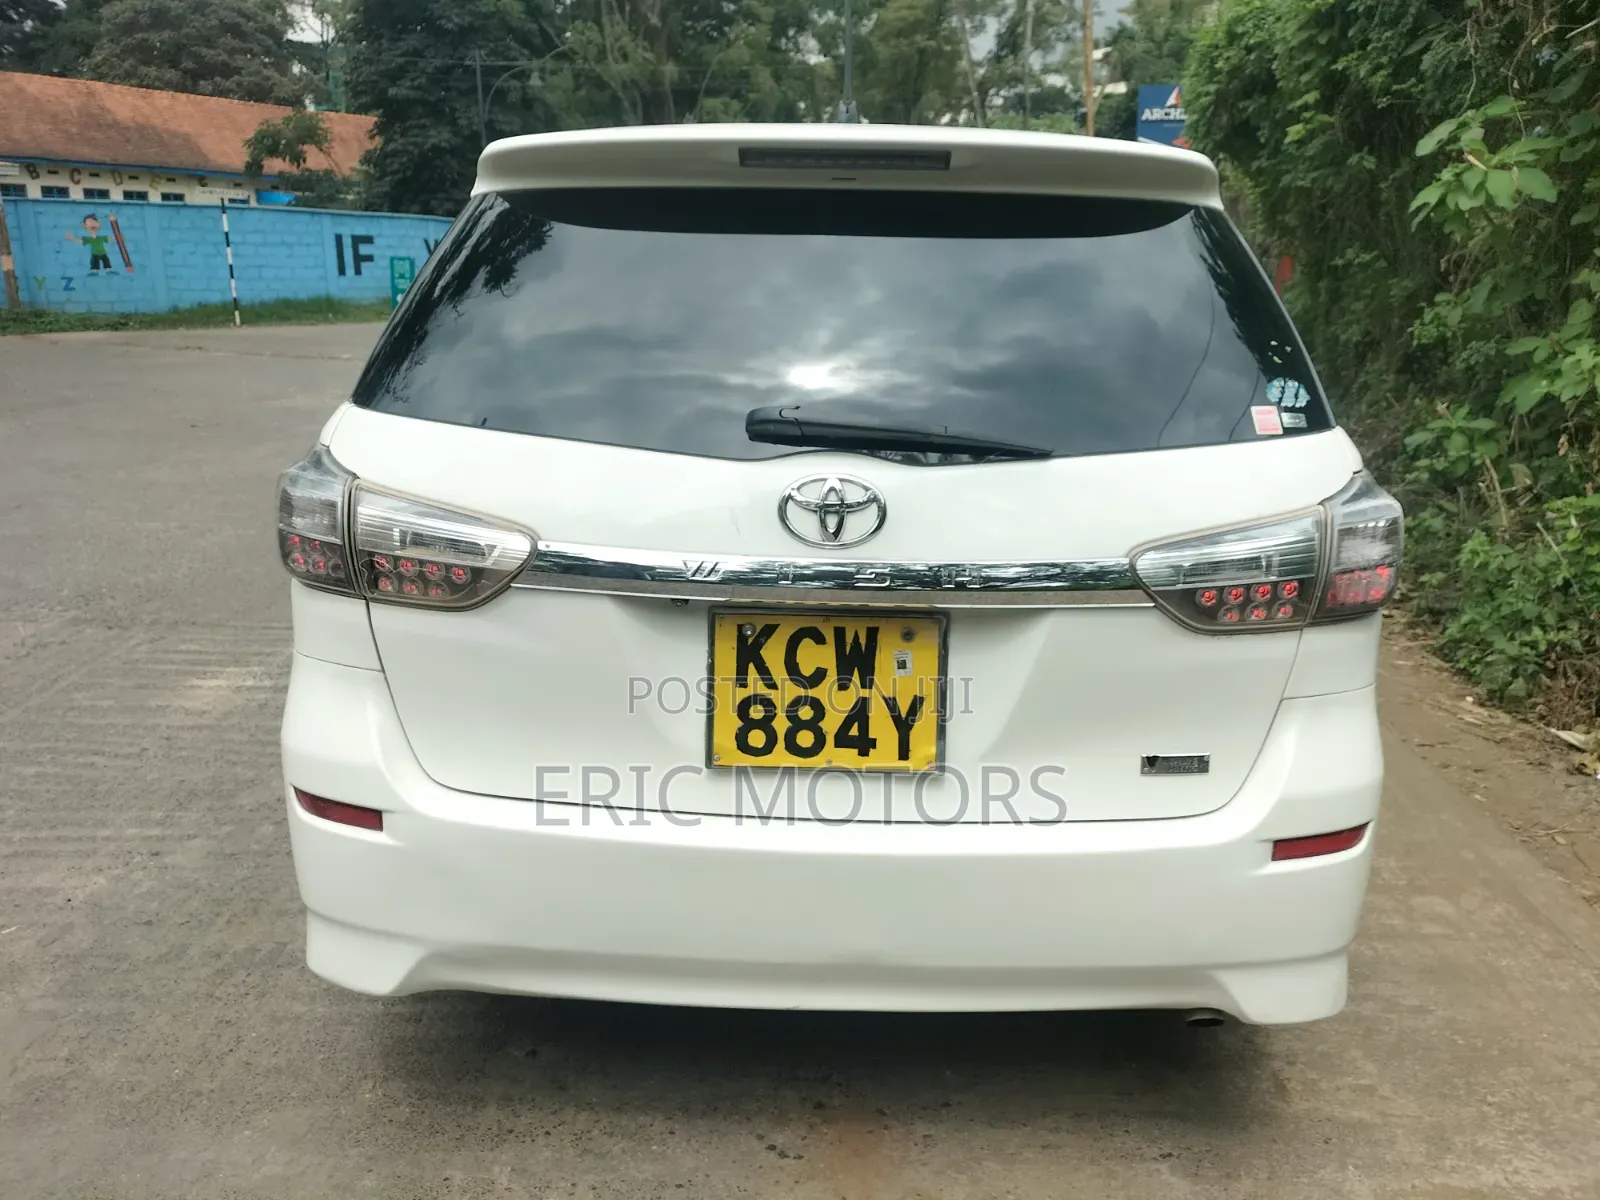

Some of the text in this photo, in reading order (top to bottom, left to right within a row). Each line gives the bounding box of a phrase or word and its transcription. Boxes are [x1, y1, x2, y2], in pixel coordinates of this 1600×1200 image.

[335, 233, 374, 276] IF
[60, 276, 76, 291] Z
[735, 622, 880, 692] KCW
[734, 693, 926, 761] 884Y
